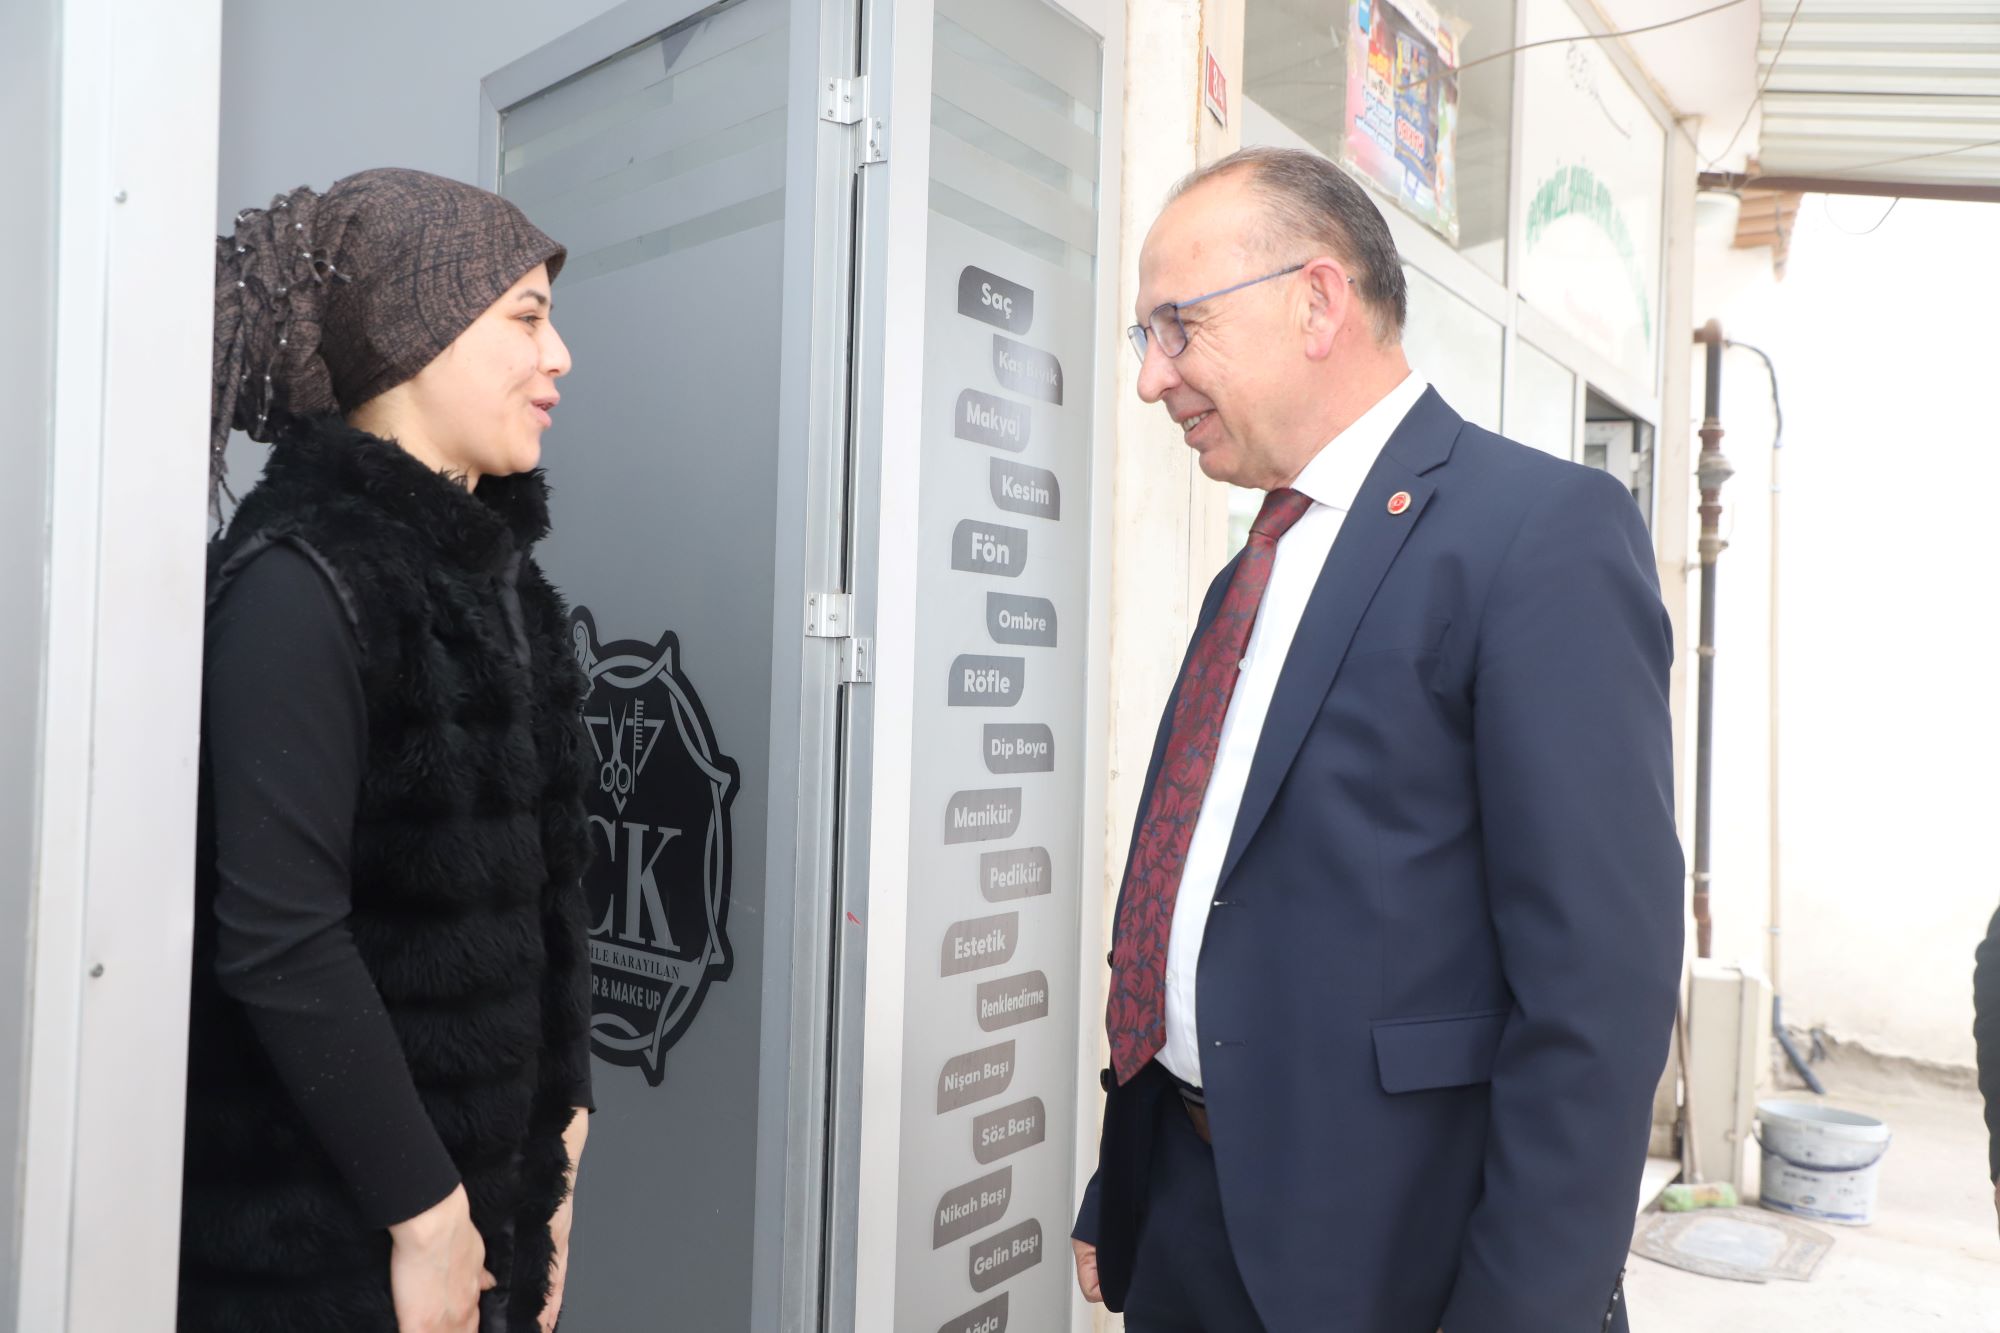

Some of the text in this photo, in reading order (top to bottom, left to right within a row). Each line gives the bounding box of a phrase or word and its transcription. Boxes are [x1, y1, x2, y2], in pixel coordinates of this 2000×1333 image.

[981, 282, 1013, 320] Saç
[999, 350, 1024, 378] Kaş
[966, 401, 1020, 442] Makyaj
[1002, 475, 1050, 505] Kesim
[971, 532, 1010, 565] Fön
[998, 609, 1047, 631] Ombre
[963, 668, 1011, 694] Röfle
[991, 737, 1048, 760] Dip Boya
[954, 804, 1013, 829] Manikür
[990, 862, 1043, 889] Pedikür
[954, 929, 1006, 960] Estetik
[612, 951, 680, 982] KARAYILAN
[601, 977, 609, 998] &
[611, 980, 644, 1008] MAKE
[646, 989, 661, 1011] UP
[981, 987, 1045, 1020] Renklendirme
[944, 1059, 1009, 1093] Nişan Başı
[981, 1115, 1036, 1146] Söz Başı
[940, 1186, 1007, 1227] Nikah Başı
[973, 1233, 1039, 1276] Gelin Başı
